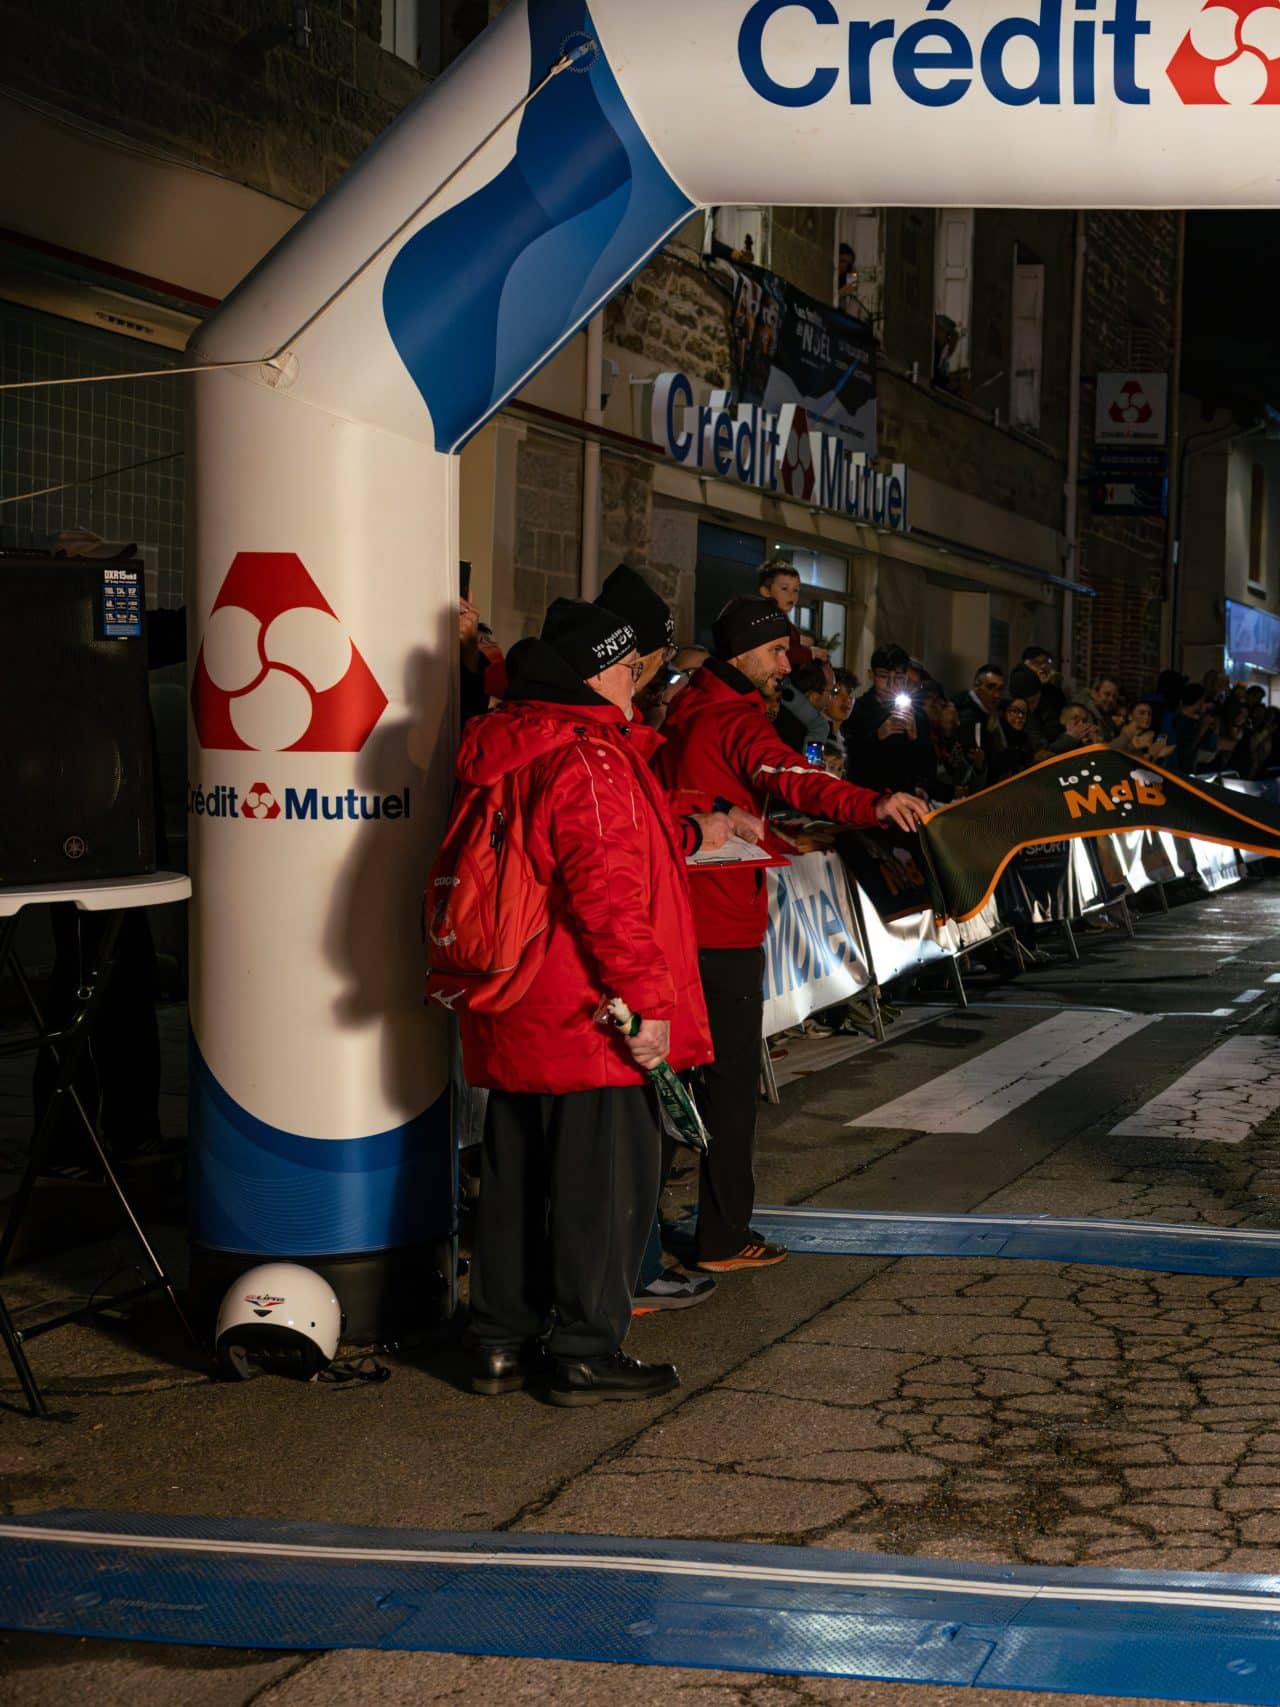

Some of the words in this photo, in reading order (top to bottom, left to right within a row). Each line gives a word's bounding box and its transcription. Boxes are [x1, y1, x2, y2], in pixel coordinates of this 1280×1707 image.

[738, 0, 1151, 107] Crédit
[664, 372, 780, 490] Crédit
[818, 433, 909, 530] Mutuel
[284, 787, 410, 820] Mutuel
